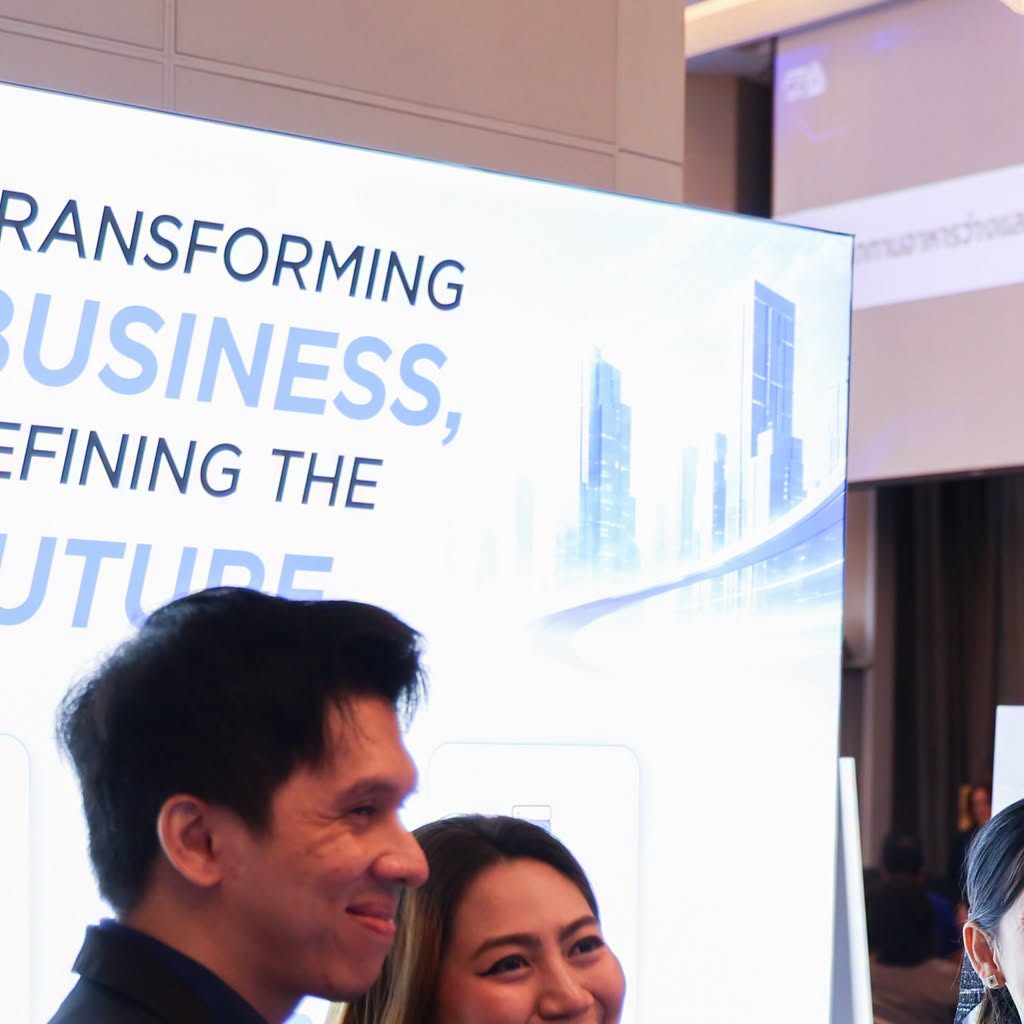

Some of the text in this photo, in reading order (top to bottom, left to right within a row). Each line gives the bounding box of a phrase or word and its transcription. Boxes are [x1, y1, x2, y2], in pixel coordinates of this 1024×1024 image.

[0, 189, 466, 311] RANSFORMING
[0, 290, 462, 446] USINESS,
[271, 448, 384, 510] THE
